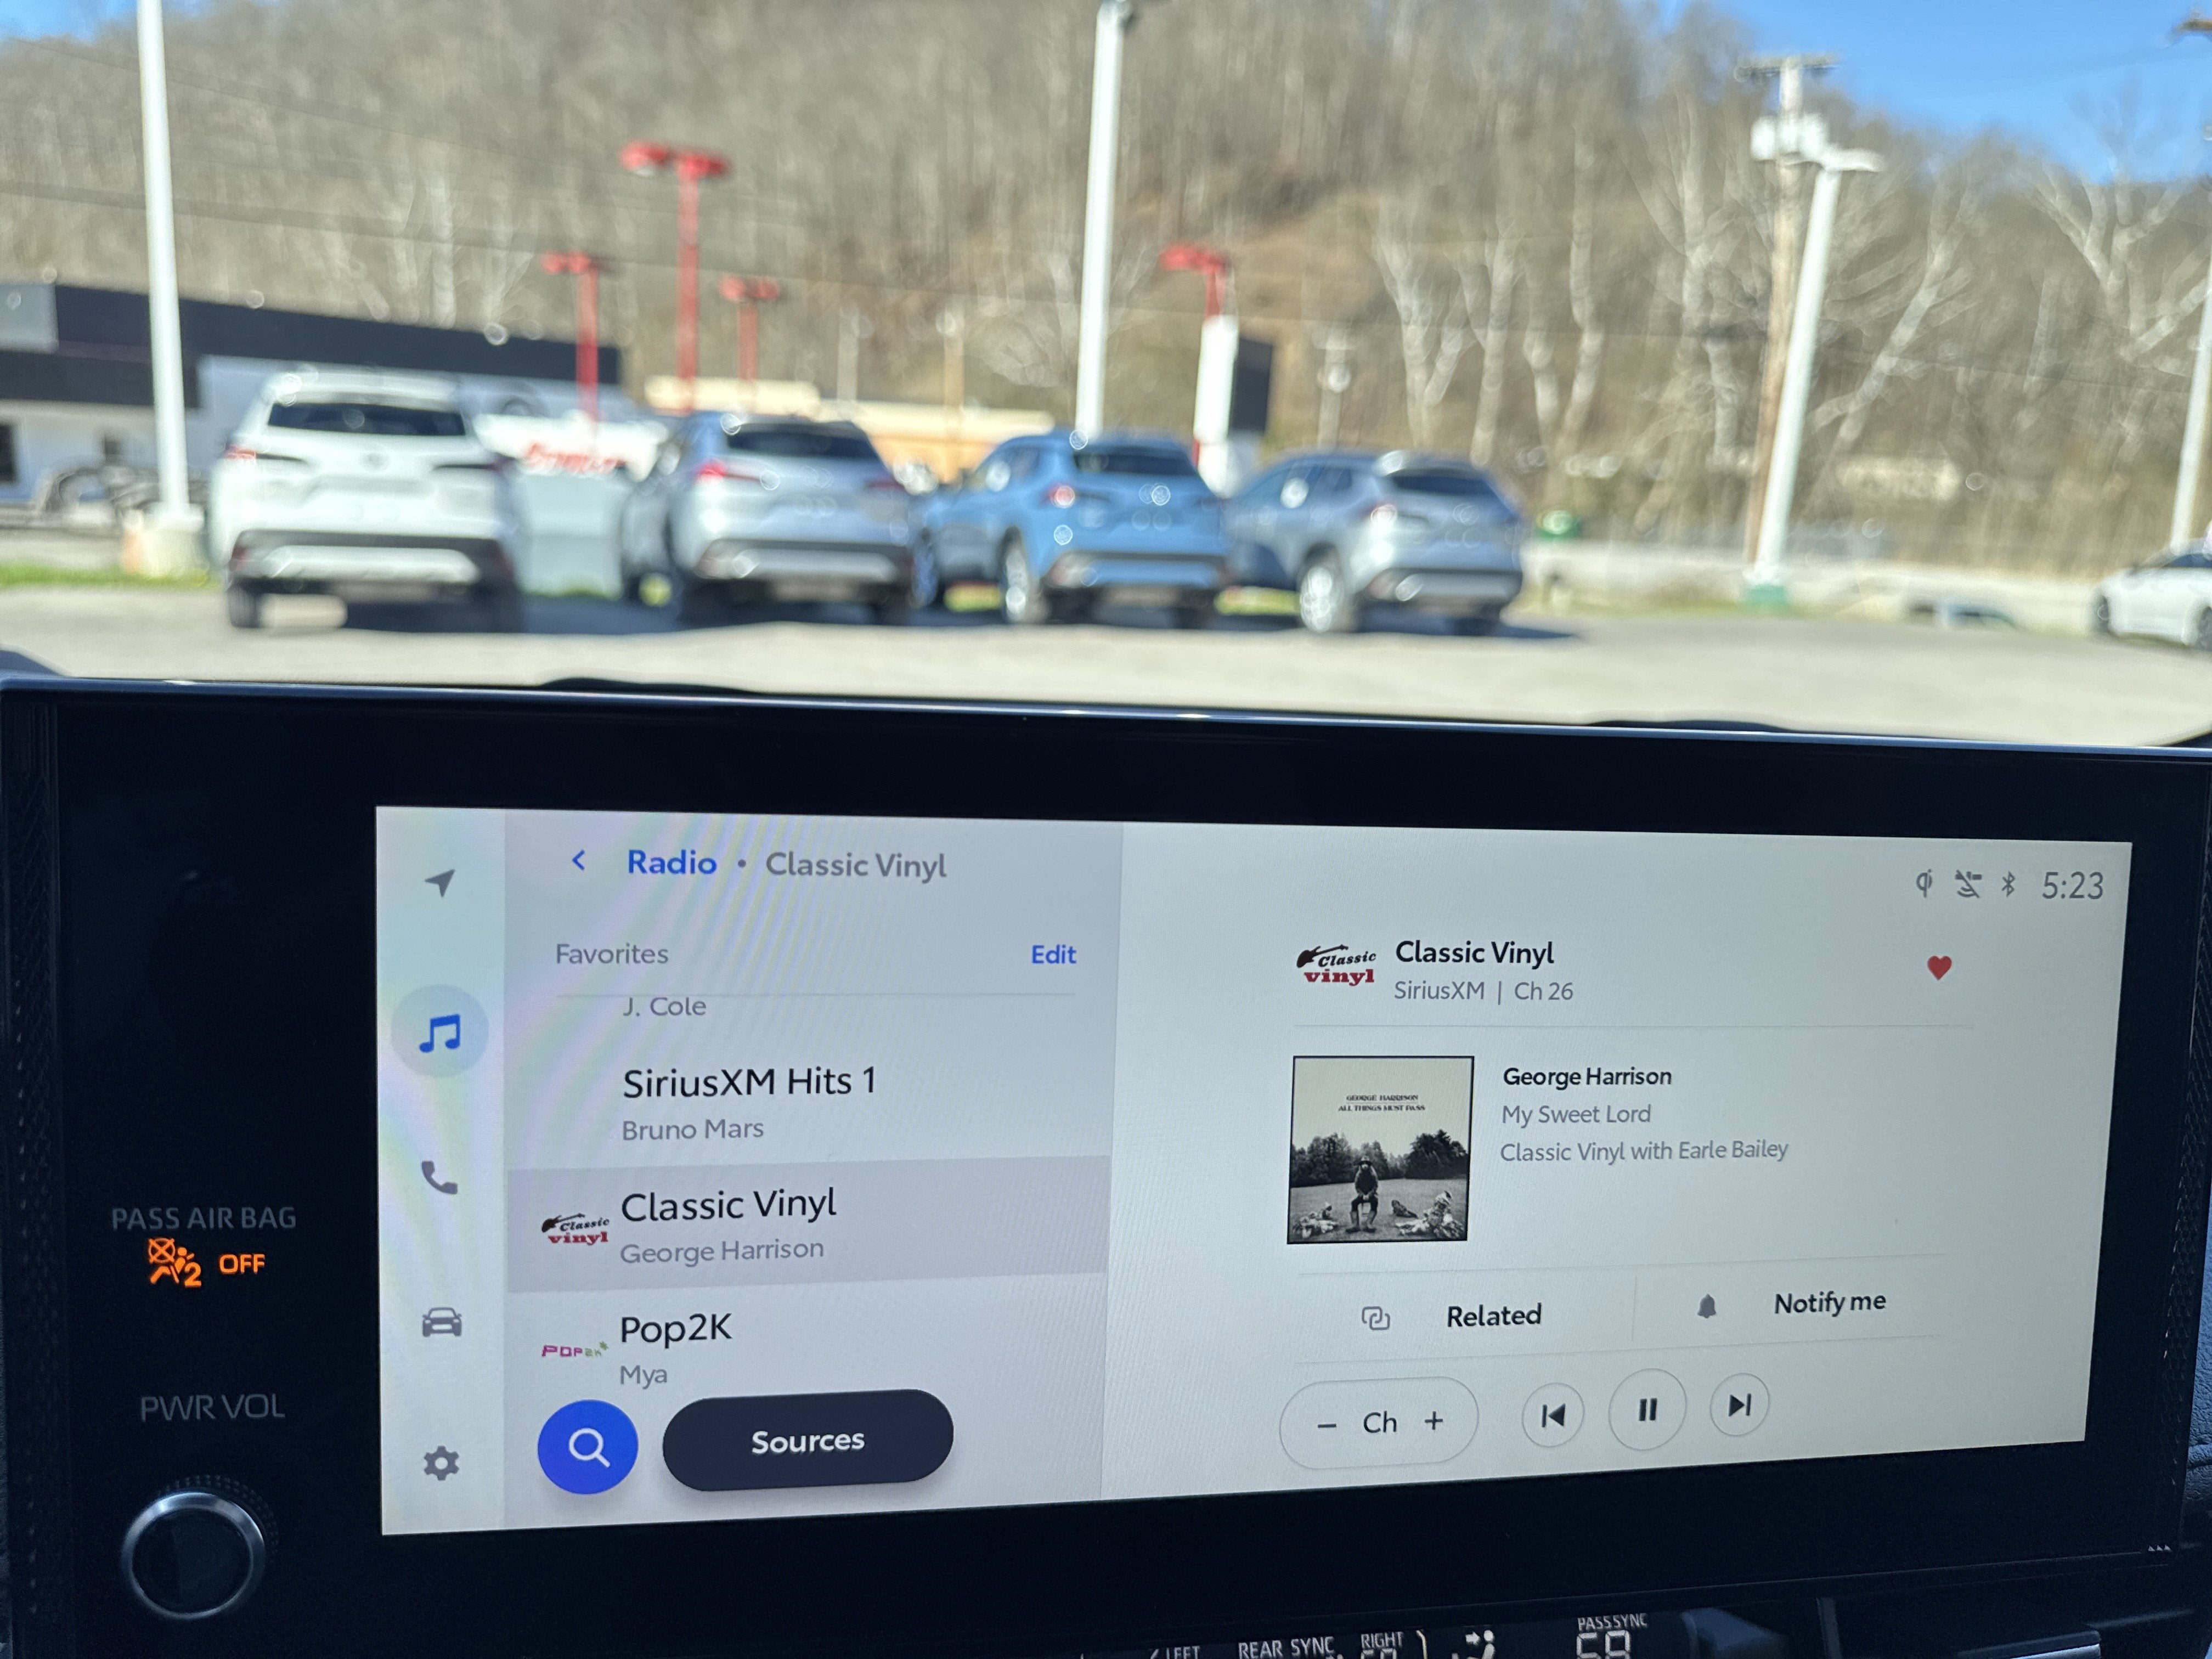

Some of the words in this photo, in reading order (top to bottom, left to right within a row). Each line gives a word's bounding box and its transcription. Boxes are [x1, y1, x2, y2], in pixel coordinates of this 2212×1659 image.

[629, 849, 716, 874] Radio
[766, 851, 868, 876] Classic
[876, 853, 947, 884] Vinyl
[2042, 871, 2103, 899] 5:23
[557, 943, 668, 964] Favorites
[1032, 944, 1076, 964] Edit
[1318, 949, 1376, 967] Classic
[1396, 940, 1485, 963] Classic
[1491, 941, 1554, 969] Vinyl
[1304, 969, 1374, 986] vinyl
[1395, 980, 1485, 1000] SiriusXM
[1515, 981, 1542, 1000] Ch
[1549, 982, 1573, 1000] 26
[623, 997, 640, 1017] J.
[650, 997, 706, 1016] Cole
[624, 1069, 774, 1098] SiriusXM
[789, 1066, 851, 1094] Hits
[864, 1066, 873, 1093] 1
[1504, 1068, 1581, 1090] George
[1587, 1066, 1672, 1085] Harrison
[1503, 1105, 1533, 1128] My
[1539, 1105, 1600, 1123] Sweet
[1607, 1104, 1651, 1122] Lord
[623, 1121, 697, 1141] Bruno
[705, 1119, 764, 1138] Mars
[1500, 1143, 1571, 1161] Classic
[1578, 1142, 1625, 1165] Vinyl
[1631, 1141, 1672, 1159] with
[1679, 1140, 1727, 1159] Earle
[1733, 1139, 1788, 1162] Bailey
[622, 1190, 743, 1222] Classic
[754, 1187, 836, 1223] Vinyl
[112, 1207, 179, 1229] PASS
[188, 1207, 233, 1228] AIR
[242, 1207, 296, 1228] BAG
[549, 1232, 607, 1245] vinyl
[219, 1254, 266, 1274] OFF
[620, 1244, 714, 1267] George
[722, 1239, 823, 1260] Harrison
[1448, 1303, 1542, 1327] Related
[1775, 1291, 1845, 1317] Notify
[1850, 1295, 1886, 1310] me
[622, 1313, 731, 1349] Pop2K
[620, 1365, 667, 1390] Mya
[142, 1395, 215, 1421] PWR
[222, 1393, 285, 1418] VOL
[1364, 1411, 1397, 1433] Ch
[752, 1431, 865, 1454] Sources
[1238, 1640, 1283, 1659] REAR
[1290, 1635, 1335, 1657] SYNC
[1361, 1631, 1403, 1649] RIGHT
